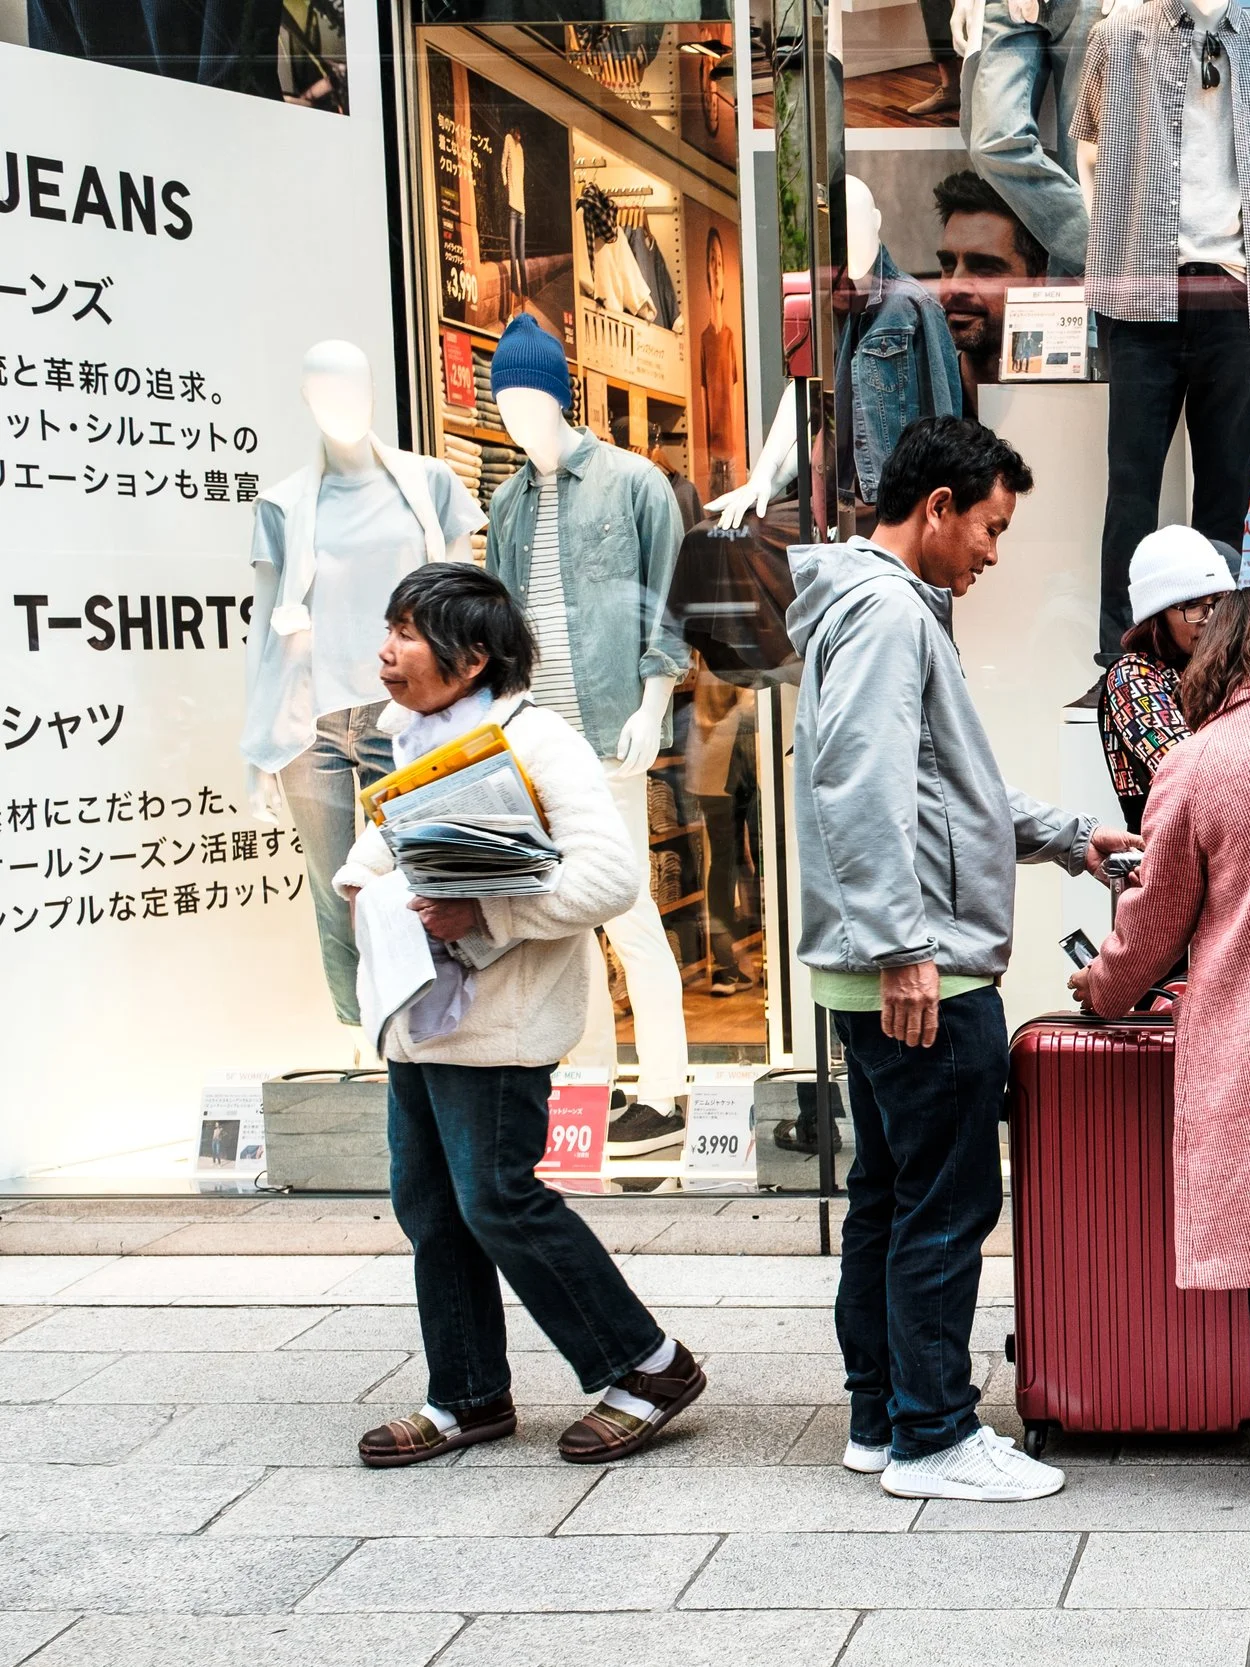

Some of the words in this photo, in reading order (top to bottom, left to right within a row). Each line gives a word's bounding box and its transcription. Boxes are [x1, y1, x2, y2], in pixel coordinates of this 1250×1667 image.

[0, 150, 193, 241] JEANS
[7, 409, 259, 454] ット・シルエットの
[3, 704, 124, 750] シャツ
[0, 785, 239, 833] 材にこだわった、
[0, 874, 304, 933] ンプルな定番カットソ
[691, 1135, 738, 1156] ¥3,990
